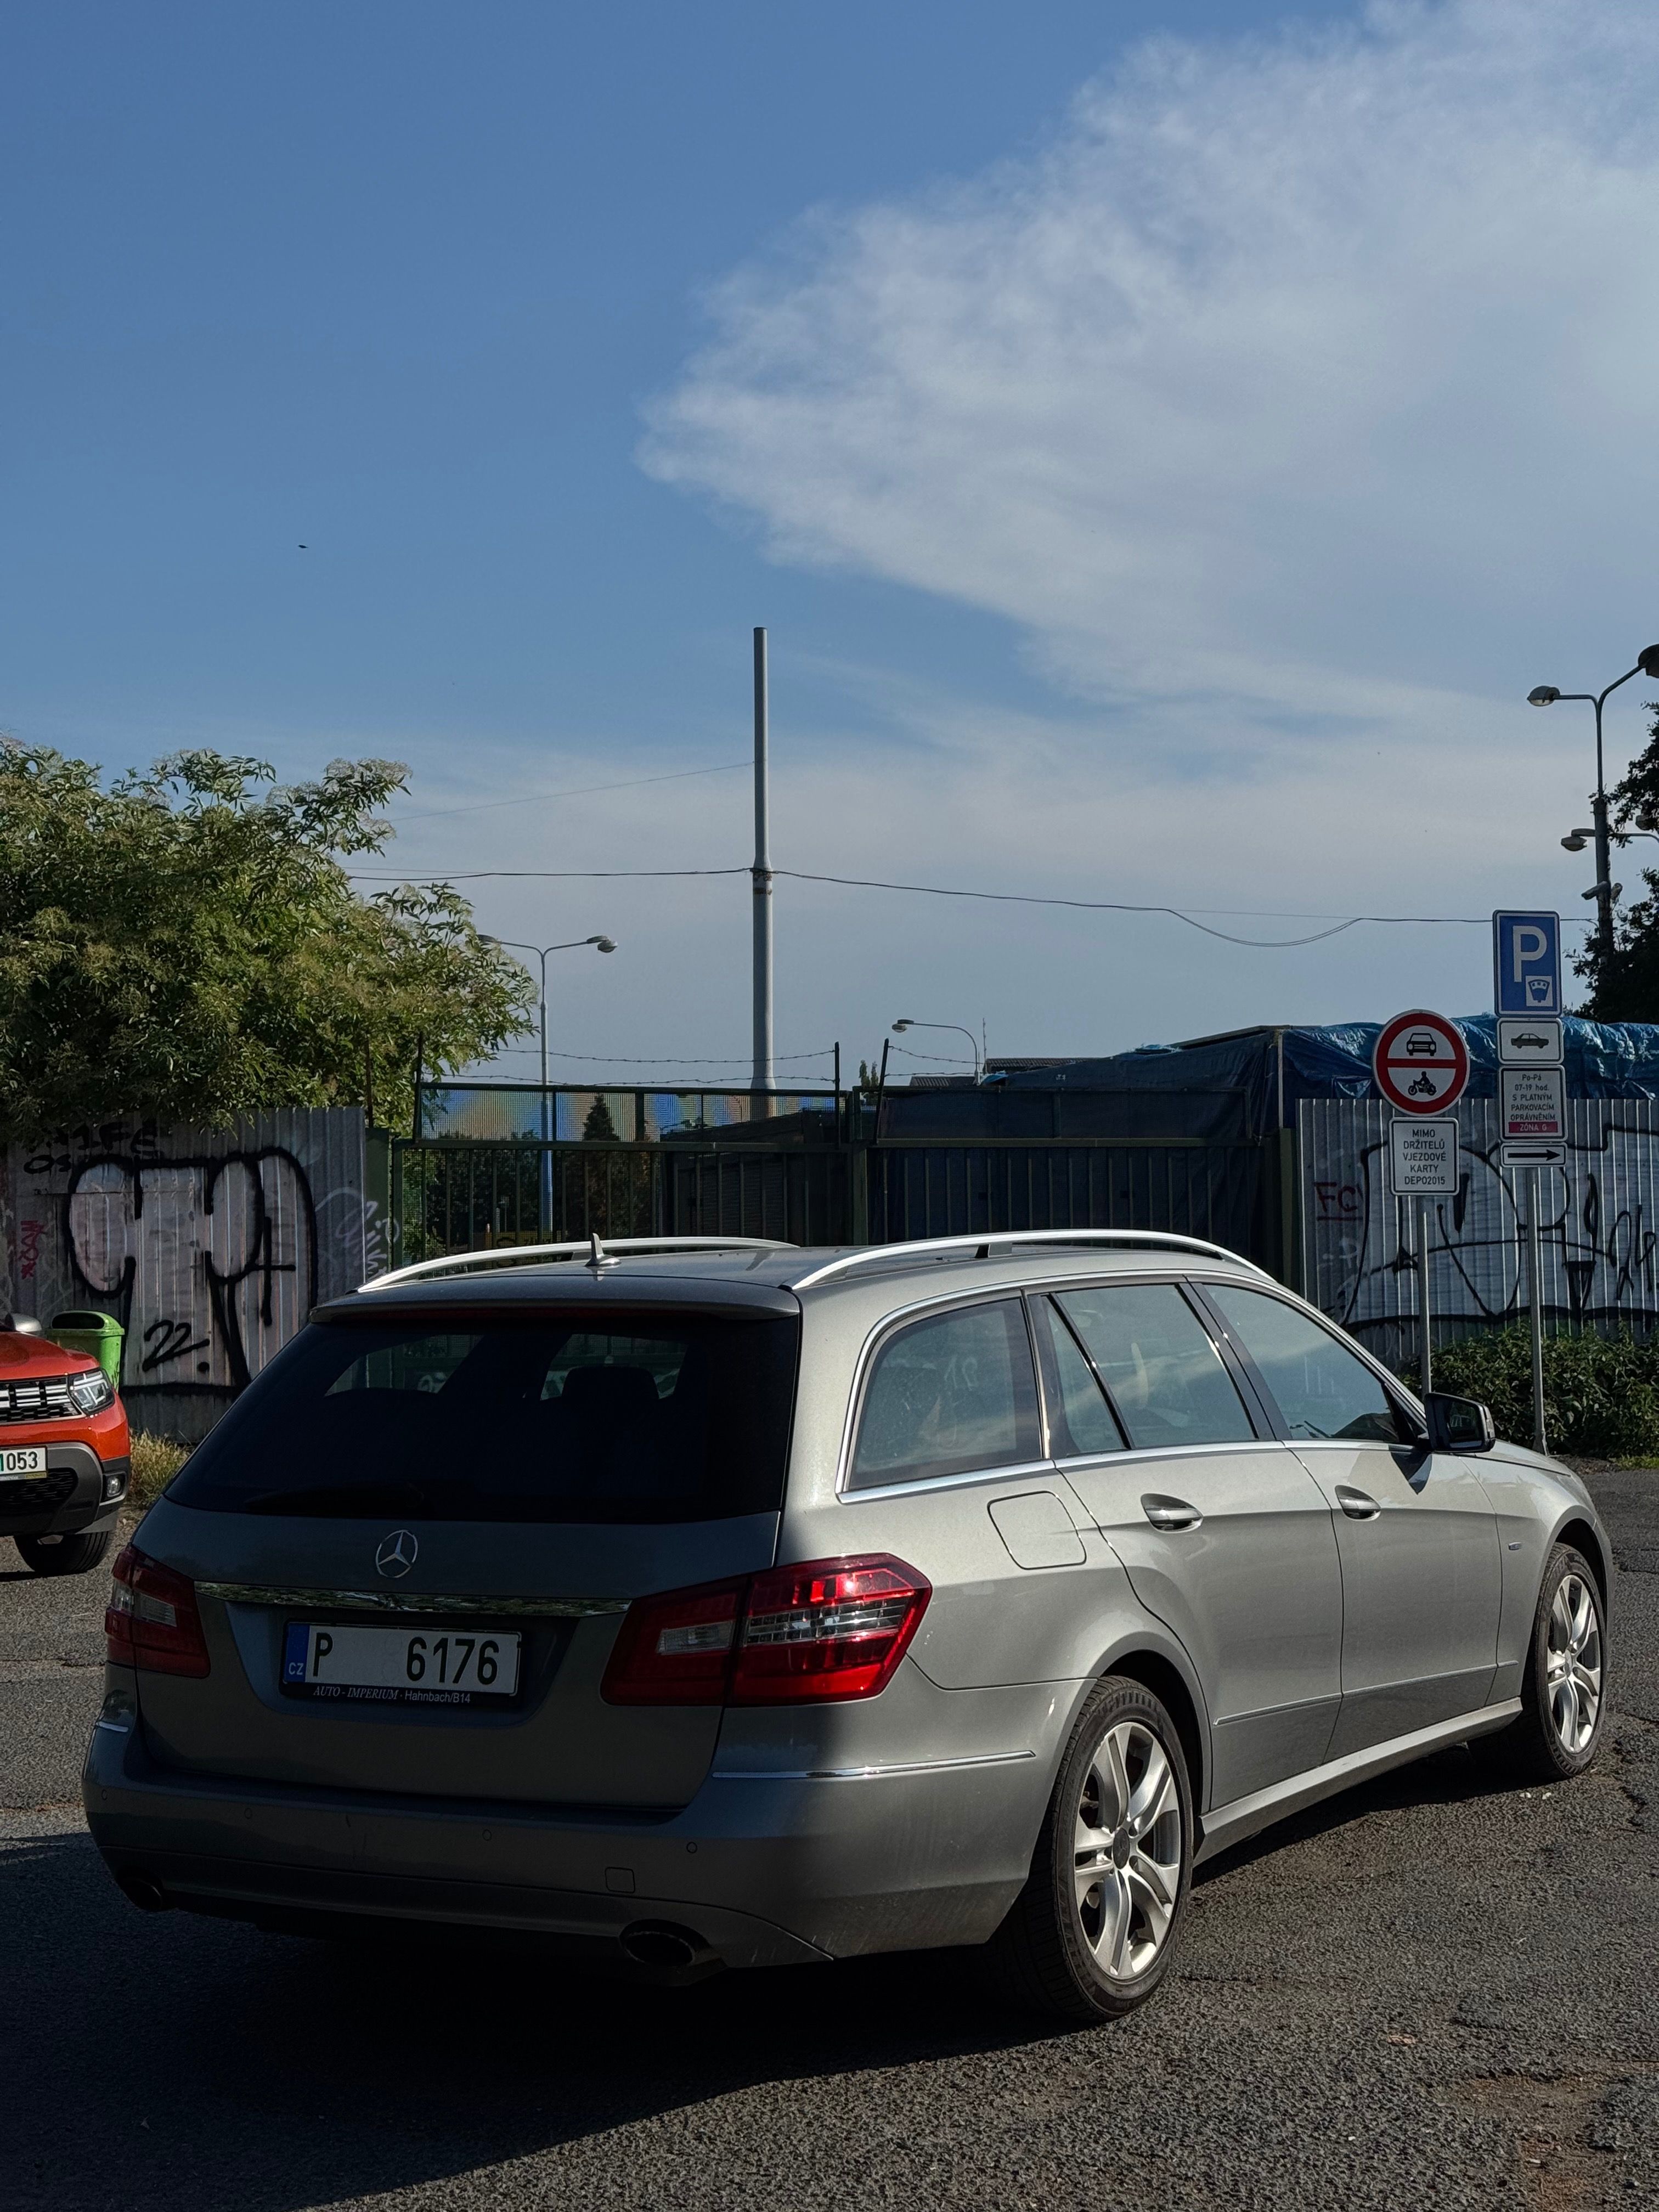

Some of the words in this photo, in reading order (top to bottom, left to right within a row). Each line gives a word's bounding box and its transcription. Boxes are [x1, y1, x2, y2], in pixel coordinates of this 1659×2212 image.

[1513, 925, 1547, 983] P
[1521, 1092, 1552, 1101] PLATNÝM
[1511, 1103, 1554, 1111] PARKOVACÍM
[1520, 1122, 1539, 1131] ZÓNA
[1412, 1129, 1435, 1137] MIMO
[1403, 1138, 1445, 1149] DRŽITELŮ
[1403, 1151, 1446, 1161] VJEZDOVÉ
[1410, 1164, 1438, 1173] KARTY
[1404, 1176, 1445, 1184] DEPO2015
[406, 1637, 500, 1686] 6176
[288, 1662, 304, 1676] CZ
[313, 1685, 340, 1697] AUTO
[348, 1687, 398, 1700] IMPERIUM
[405, 1692, 471, 1704] Hahnbach/B14
